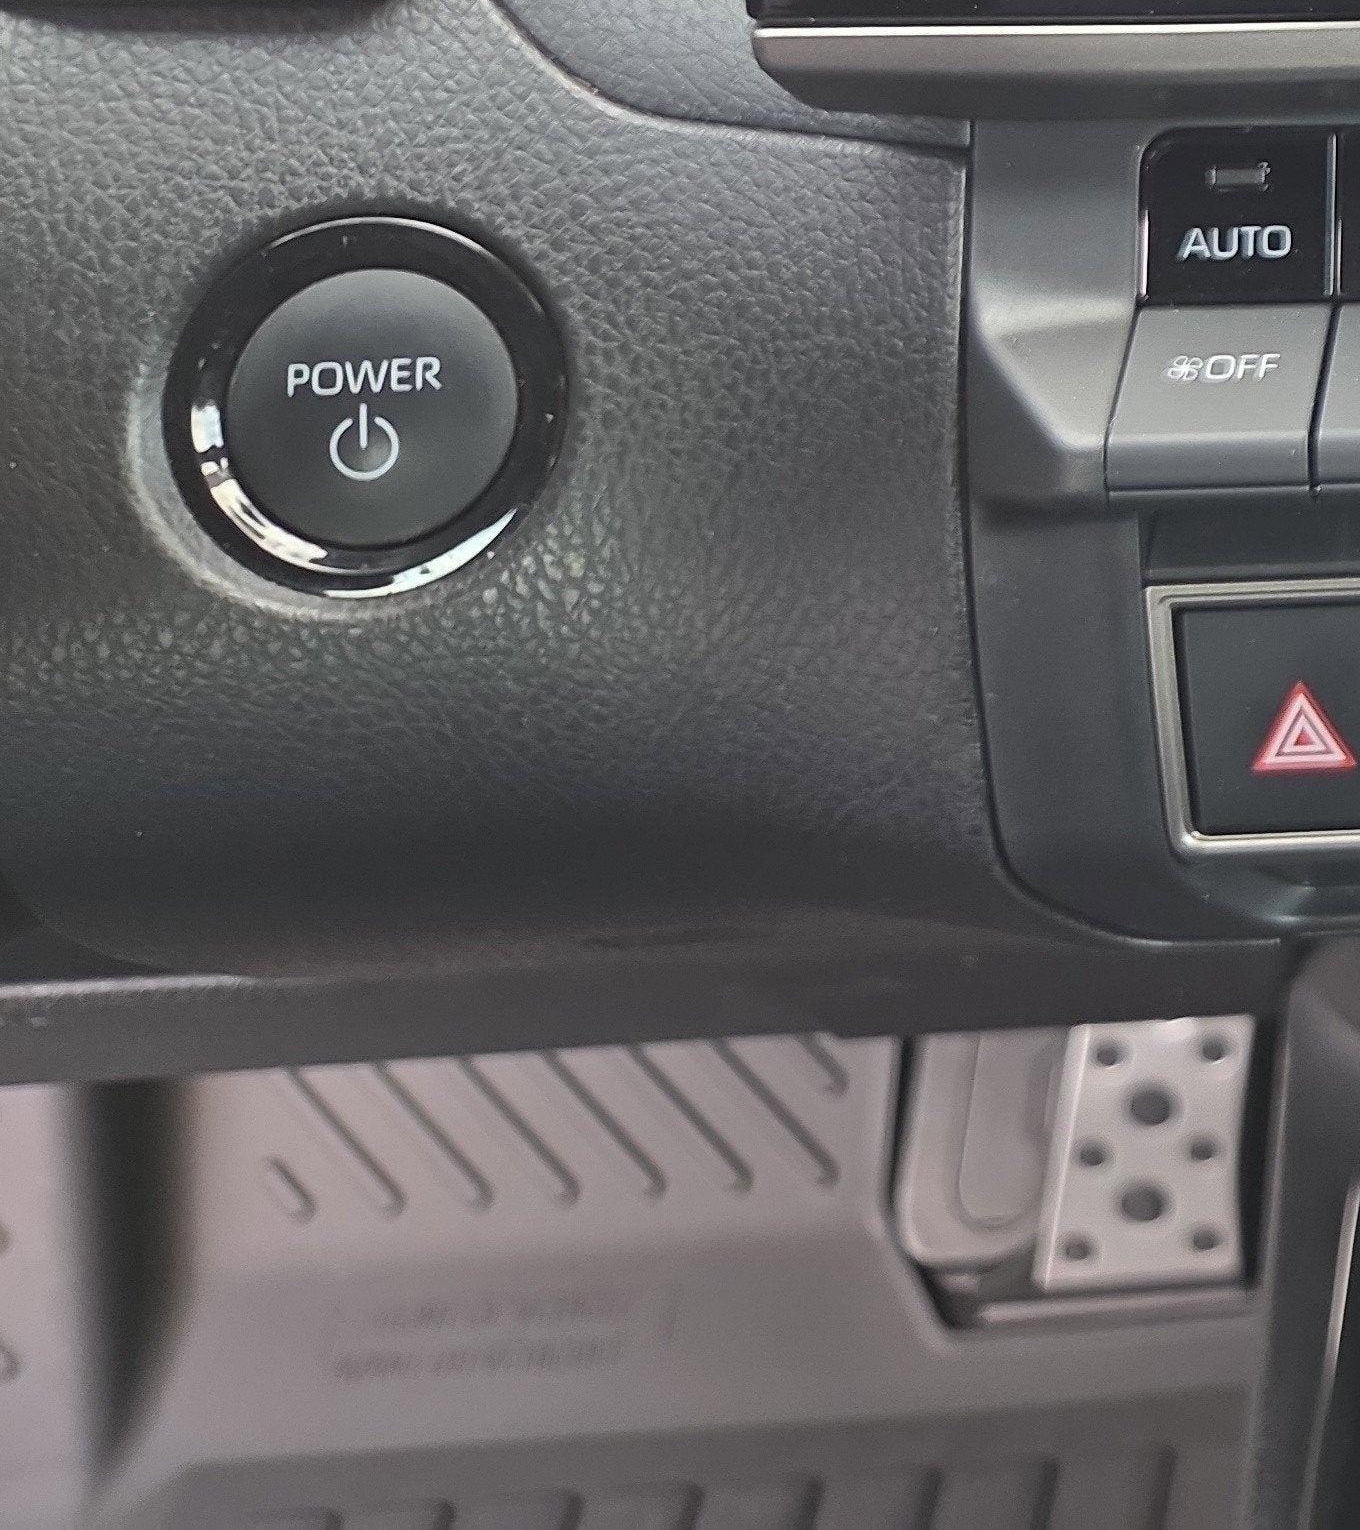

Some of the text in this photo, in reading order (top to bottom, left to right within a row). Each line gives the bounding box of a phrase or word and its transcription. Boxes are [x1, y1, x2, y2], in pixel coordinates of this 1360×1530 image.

[1178, 224, 1292, 260] AUTO
[287, 356, 442, 398] POWER
[1202, 353, 1281, 380] OFF
